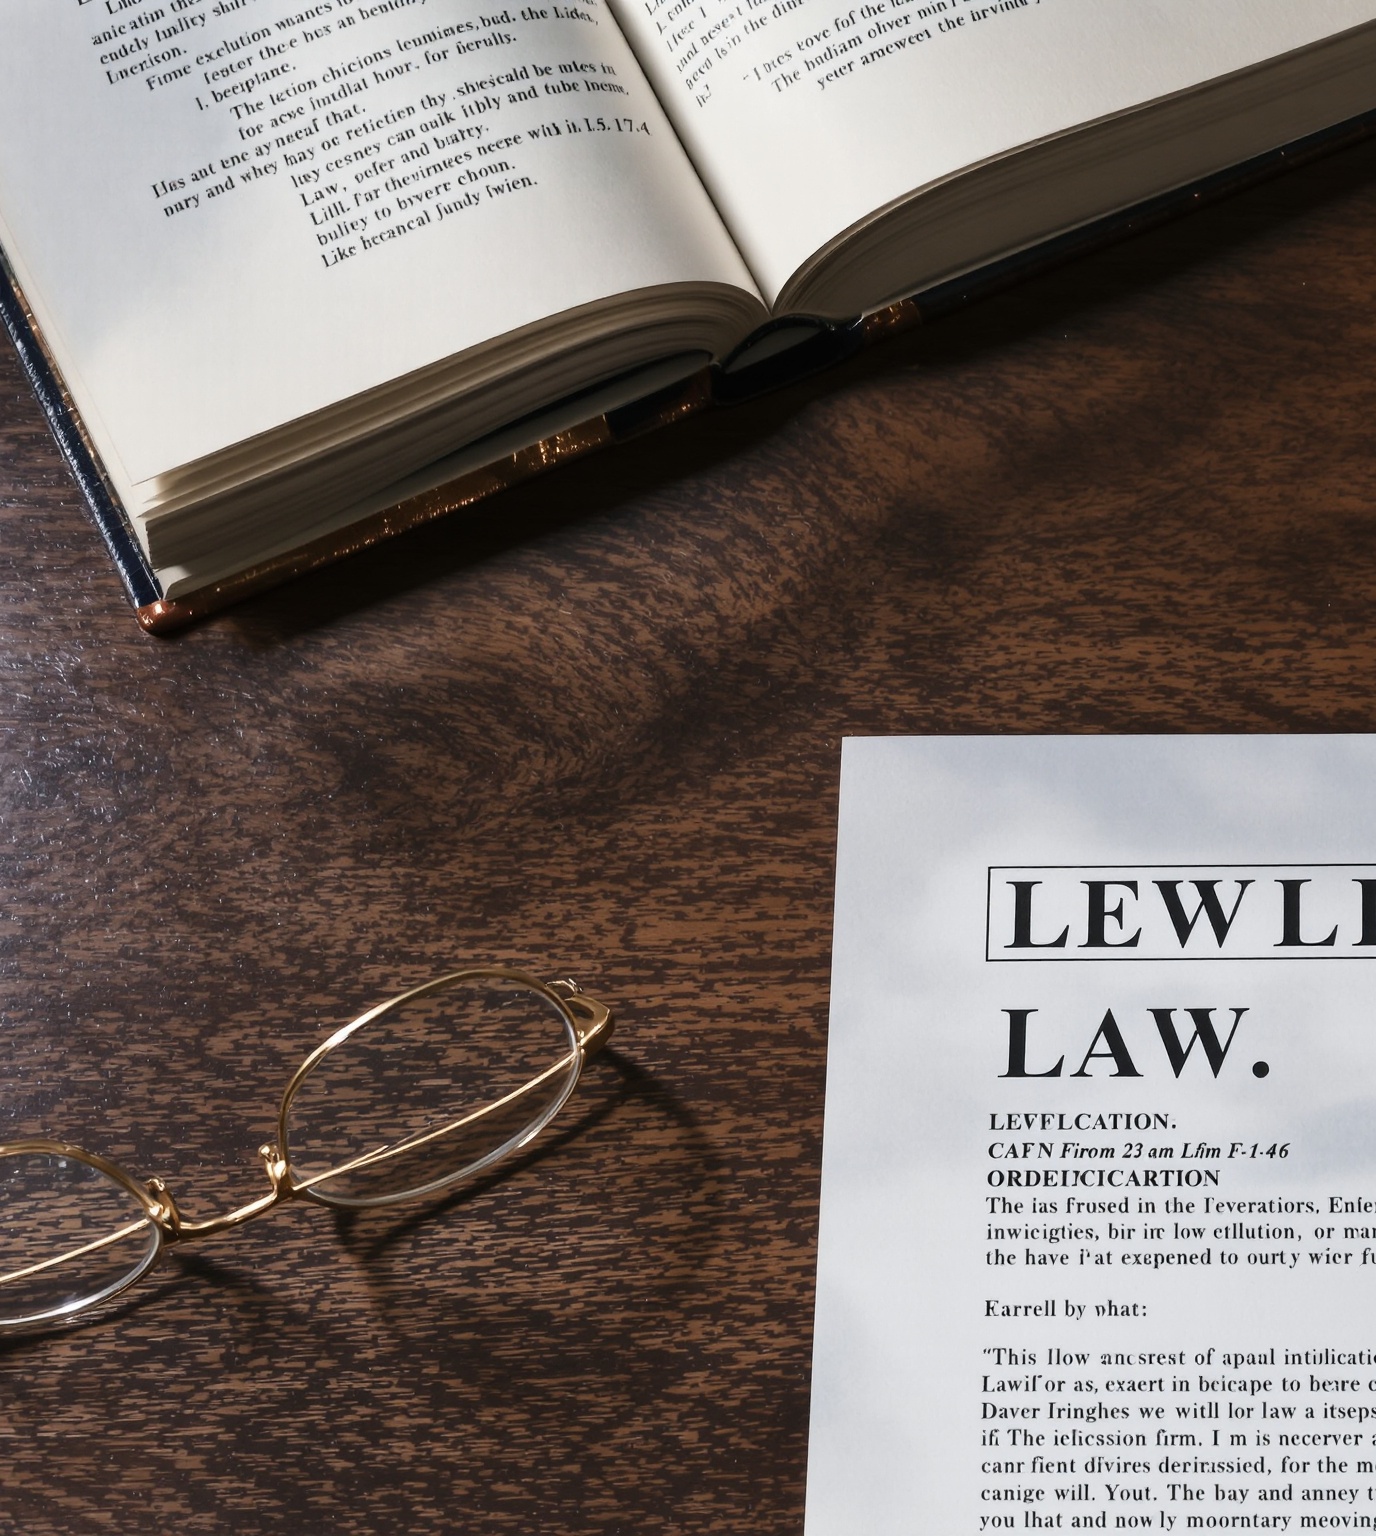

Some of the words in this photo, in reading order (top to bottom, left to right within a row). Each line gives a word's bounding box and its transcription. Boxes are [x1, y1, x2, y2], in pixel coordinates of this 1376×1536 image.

[859, 3, 886, 20] the
[937, 16, 966, 33] the
[507, 85, 540, 104] and
[229, 100, 265, 121] The
[325, 103, 366, 127] that.
[205, 175, 236, 199] and
[419, 93, 446, 111] thy
[531, 63, 553, 77] be
[400, 141, 431, 164] and
[373, 207, 392, 221] to
[996, 1007, 1270, 1080] LAW.
[1121, 1142, 1144, 1159] 23
[1147, 1146, 1174, 1160] am
[985, 1196, 1024, 1215] The
[1031, 1197, 1058, 1214] ias
[1137, 1197, 1156, 1214] in
[1164, 1196, 1196, 1215] the
[1107, 1222, 1136, 1240] bir
[1173, 1222, 1207, 1240] low
[1314, 1226, 1336, 1240] or
[985, 1248, 1017, 1266] the
[1025, 1247, 1070, 1266] have
[1219, 1250, 1239, 1265] to
[1064, 1298, 1087, 1321] by
[1194, 1347, 1216, 1366] of
[1073, 1379, 1099, 1395] as,
[1171, 1375, 1191, 1393] in
[1281, 1377, 1301, 1392] to
[980, 1401, 1041, 1420] Daver
[1138, 1406, 1165, 1420] we
[1261, 1401, 1297, 1420] law
[1304, 1406, 1315, 1420] a
[1006, 1428, 1046, 1447] The
[1229, 1433, 1248, 1447] m
[1255, 1429, 1271, 1447] is
[1280, 1455, 1311, 1474] for
[1316, 1455, 1349, 1474] the
[1053, 1483, 1096, 1502] will.
[1166, 1483, 1206, 1502] The
[1213, 1483, 1250, 1505] bay
[1258, 1483, 1293, 1502] and
[1301, 1488, 1360, 1505] anney
[979, 1515, 1015, 1532] you
[1070, 1510, 1107, 1529] and
[1114, 1515, 1153, 1529] now
[1186, 1513, 1292, 1532] moorntary
